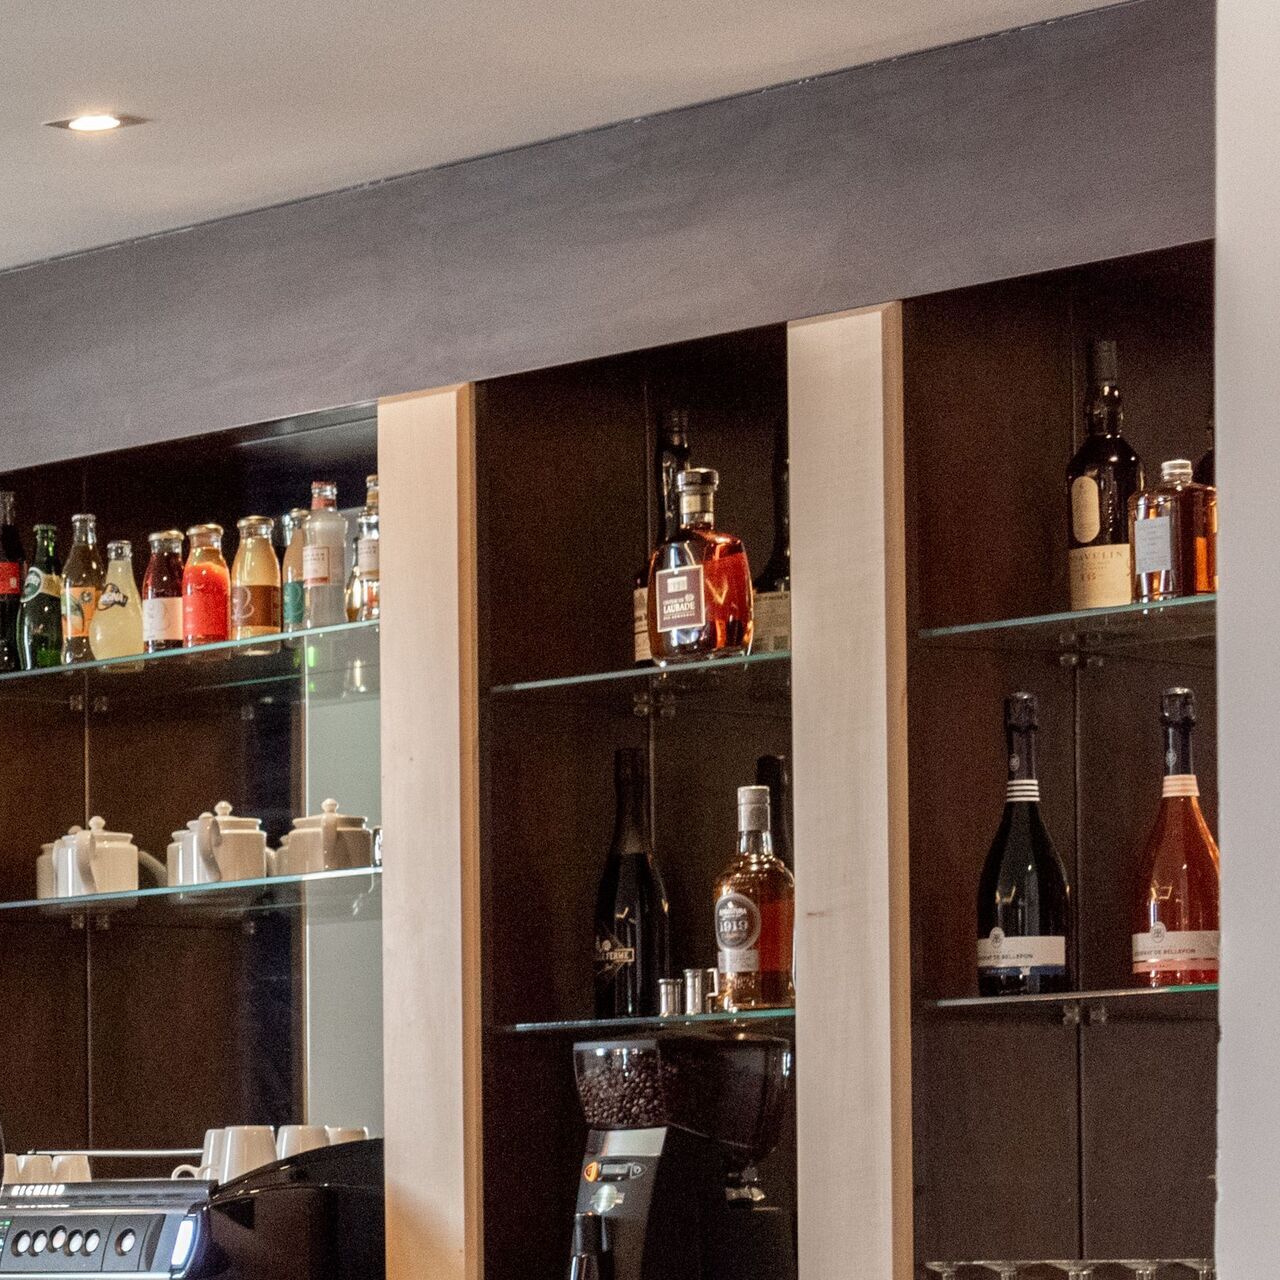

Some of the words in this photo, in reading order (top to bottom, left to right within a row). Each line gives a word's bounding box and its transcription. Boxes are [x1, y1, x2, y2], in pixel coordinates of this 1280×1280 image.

[663, 601, 695, 614] LAUBADE
[720, 920, 748, 933] 1919
[11, 1184, 65, 1196] RICHARD
